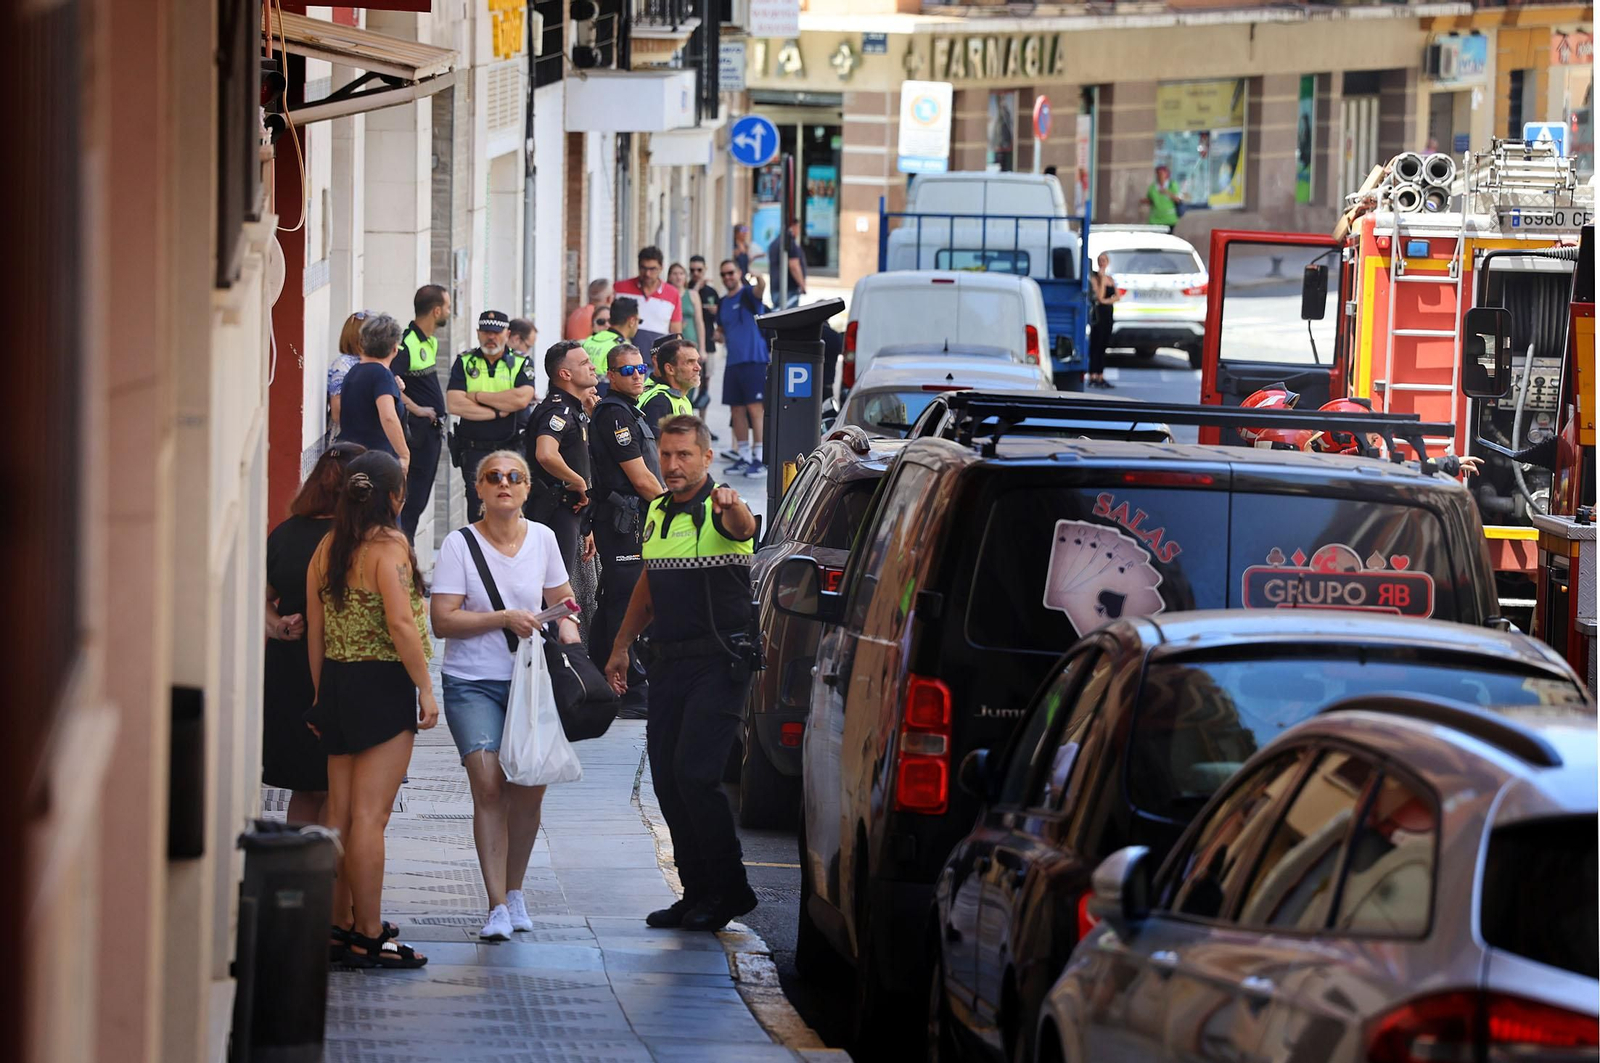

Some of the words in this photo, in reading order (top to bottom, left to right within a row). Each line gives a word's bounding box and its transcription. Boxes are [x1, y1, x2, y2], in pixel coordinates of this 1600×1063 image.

[929, 34, 1067, 79] FARMACIA
[1524, 210, 1565, 227] 6980
[788, 366, 808, 393] P
[1092, 492, 1182, 563] SALAS
[1264, 579, 1366, 605] GRUPO
